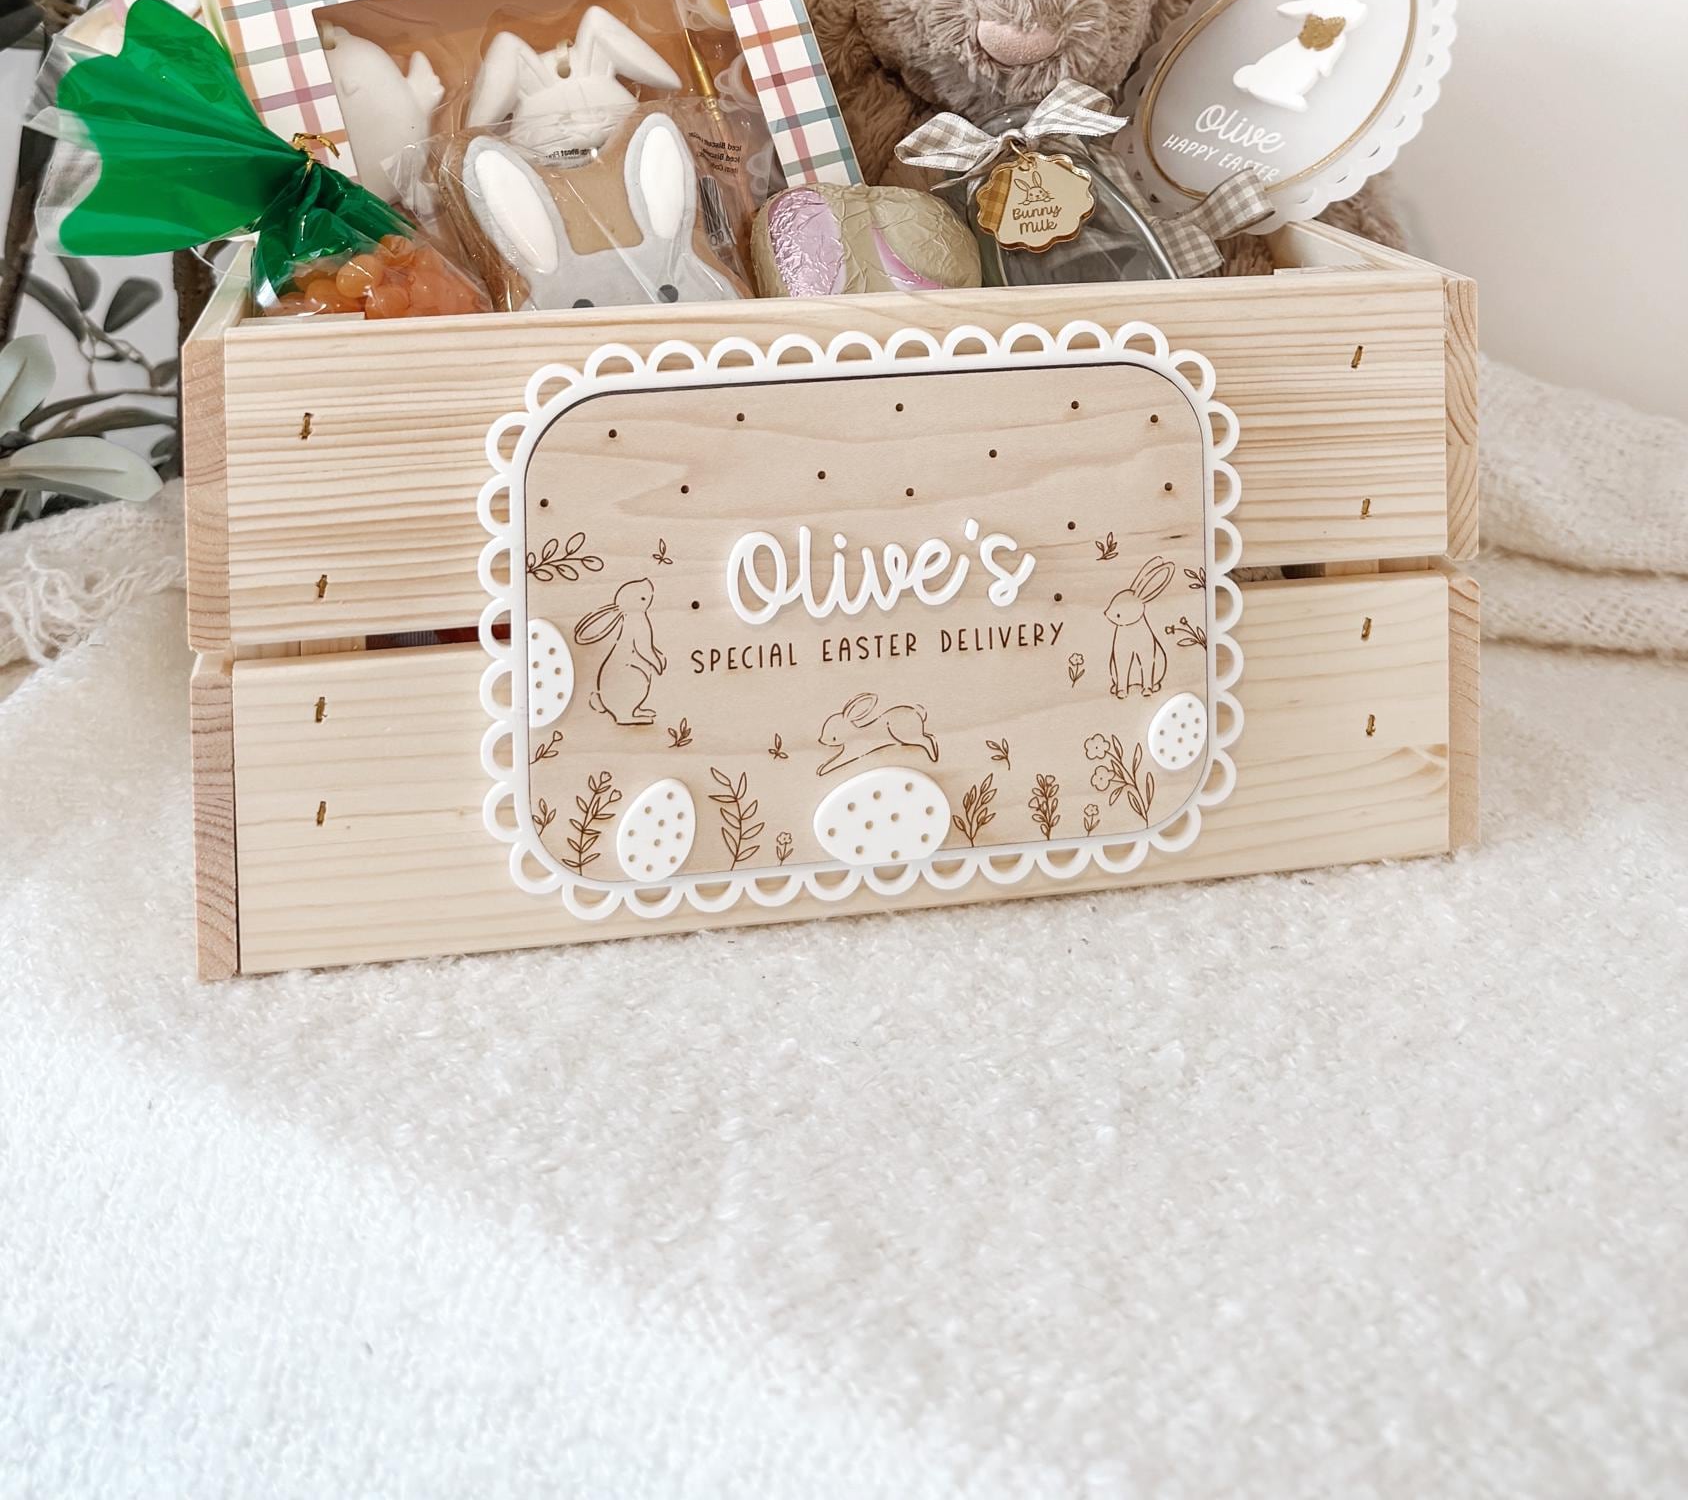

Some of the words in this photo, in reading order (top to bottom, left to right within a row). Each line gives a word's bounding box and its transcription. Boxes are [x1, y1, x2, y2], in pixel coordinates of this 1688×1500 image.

[1162, 133, 1219, 162] HAPPY
[1195, 104, 1286, 154] Olive
[1012, 204, 1063, 221] Bunny
[1019, 218, 1058, 235] Milk
[726, 517, 1037, 626] Olive's
[690, 642, 798, 674] SPECIAL
[822, 631, 918, 663] EASTER
[941, 621, 1064, 654] DELIVERY
